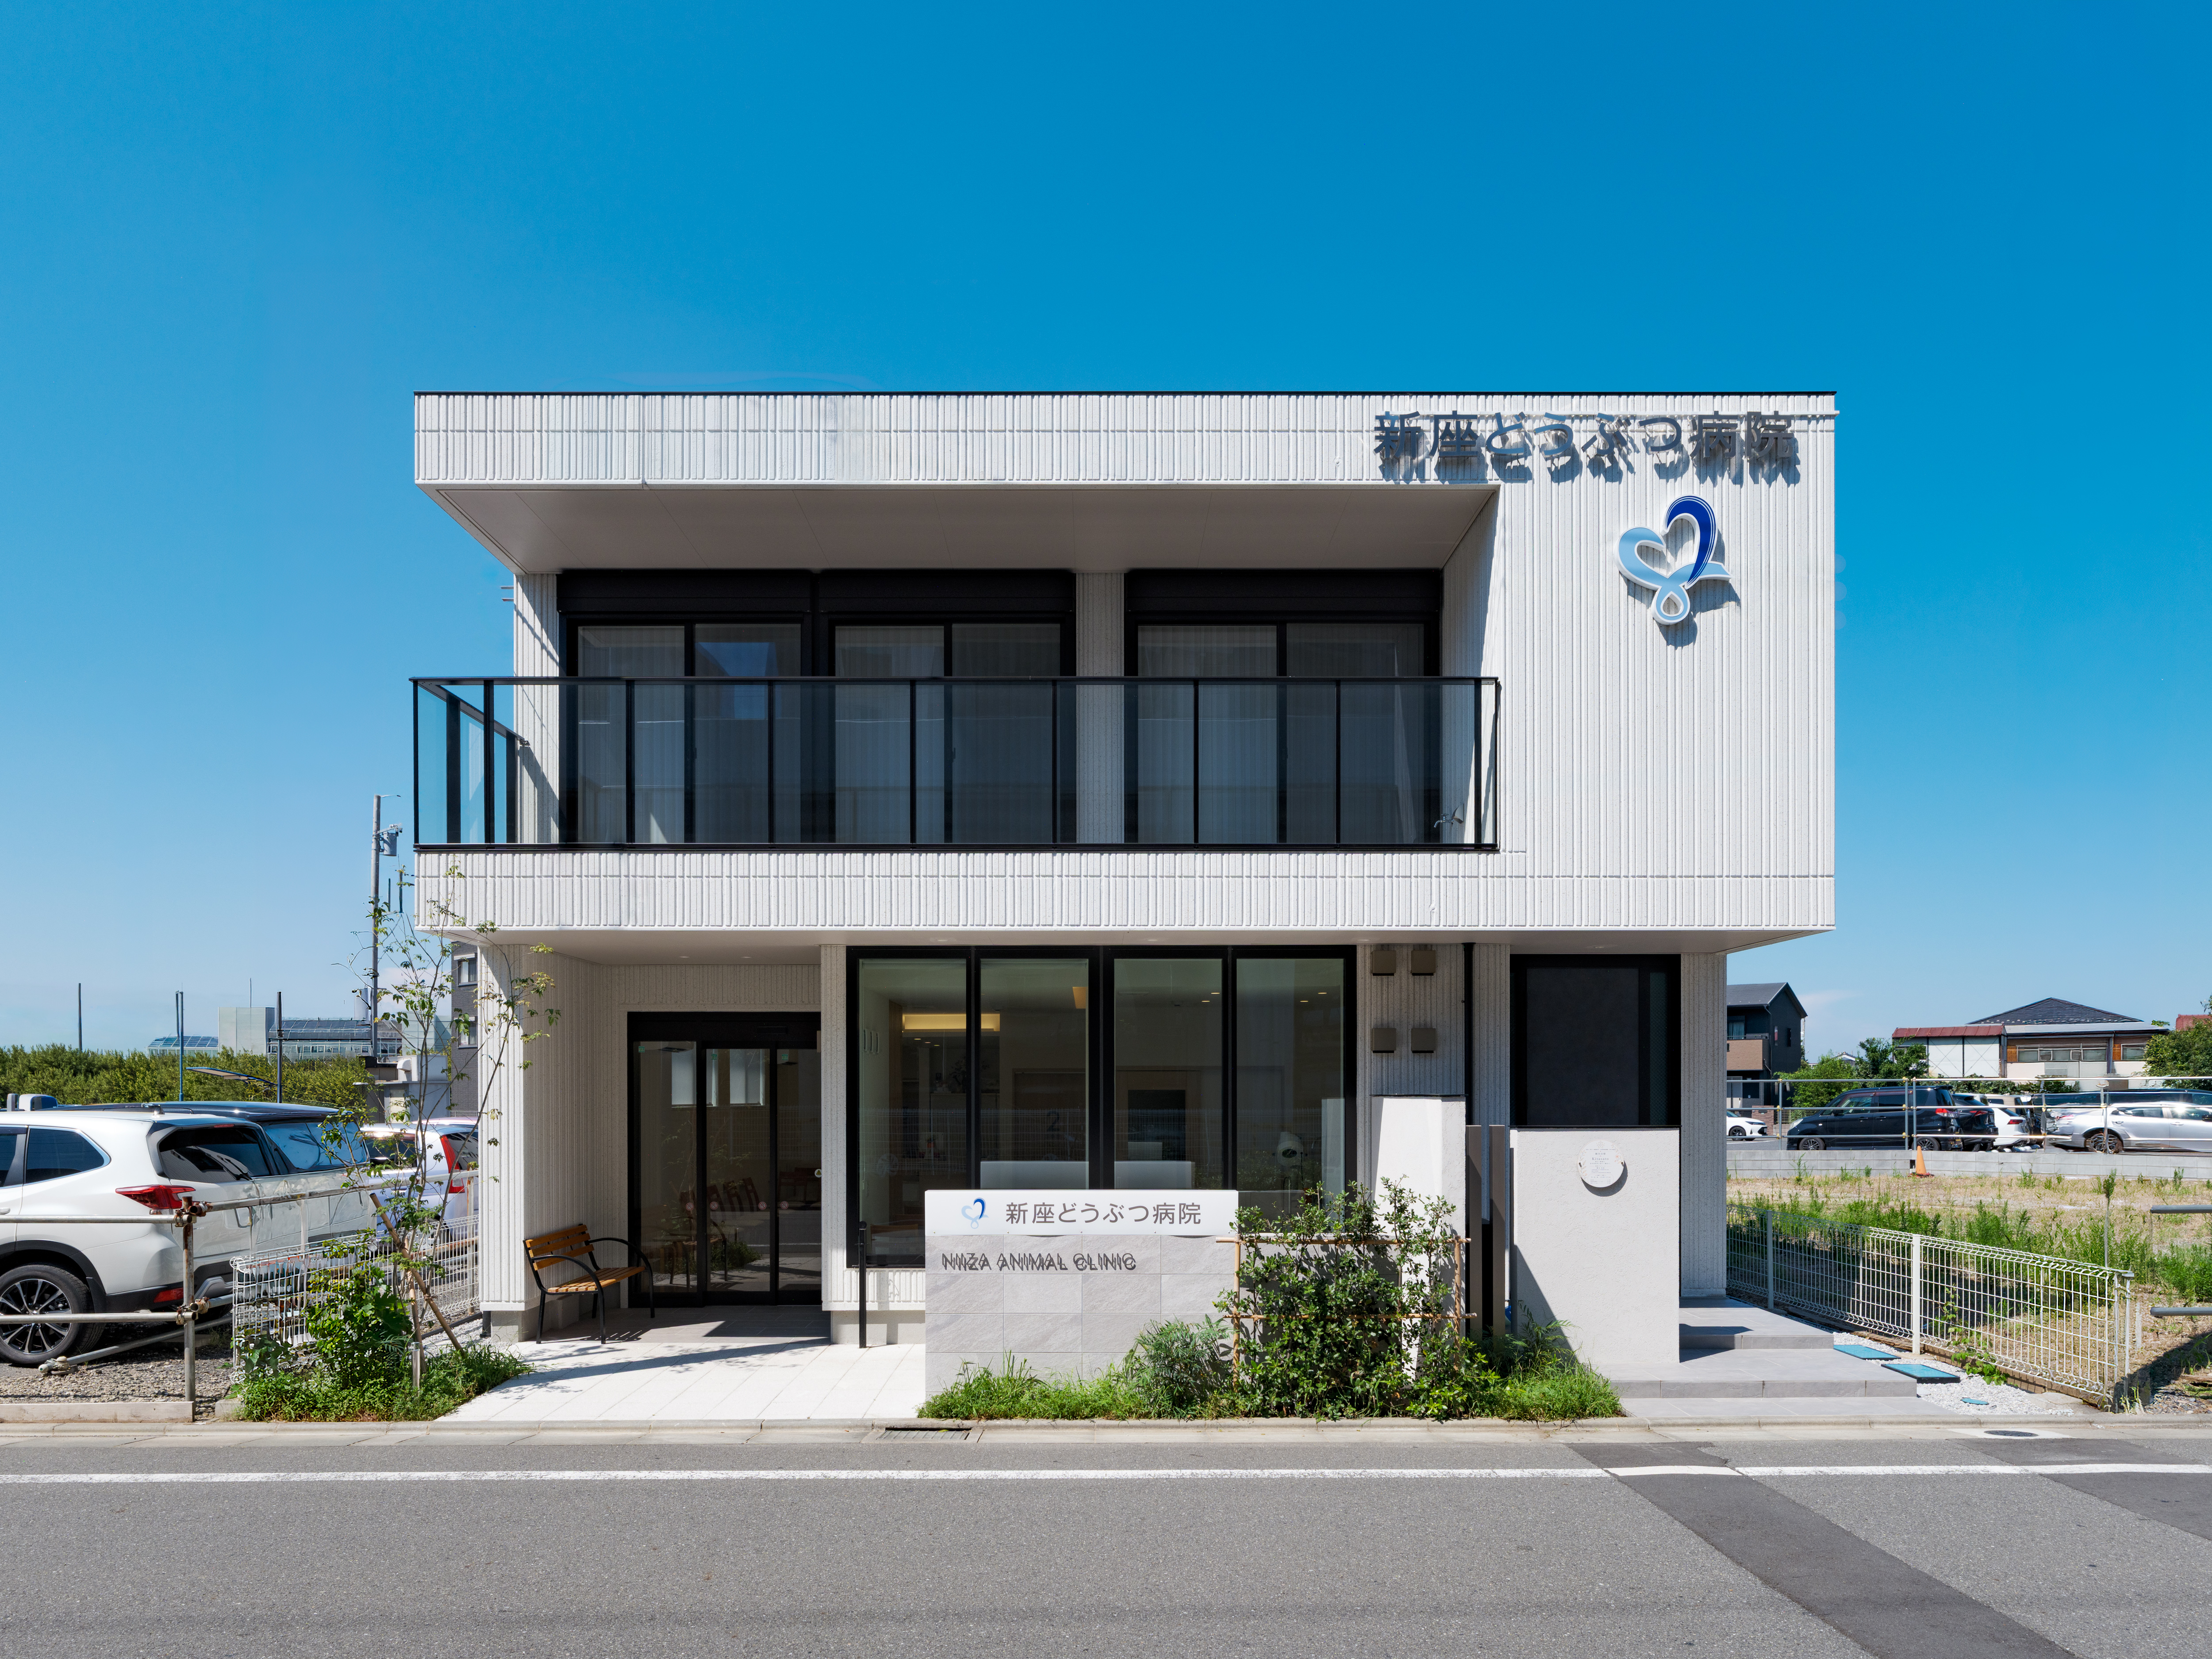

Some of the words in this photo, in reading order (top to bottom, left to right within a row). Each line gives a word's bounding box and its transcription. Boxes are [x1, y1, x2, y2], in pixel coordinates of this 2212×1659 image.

[1373, 410, 1794, 459] 新座どうぶつ病院
[1006, 1202, 1201, 1225] 新座どうぶつ病院
[942, 1253, 992, 1271] NIIZA
[996, 1253, 1068, 1271] ANIMAL
[1073, 1253, 1137, 1271] CLINIC
